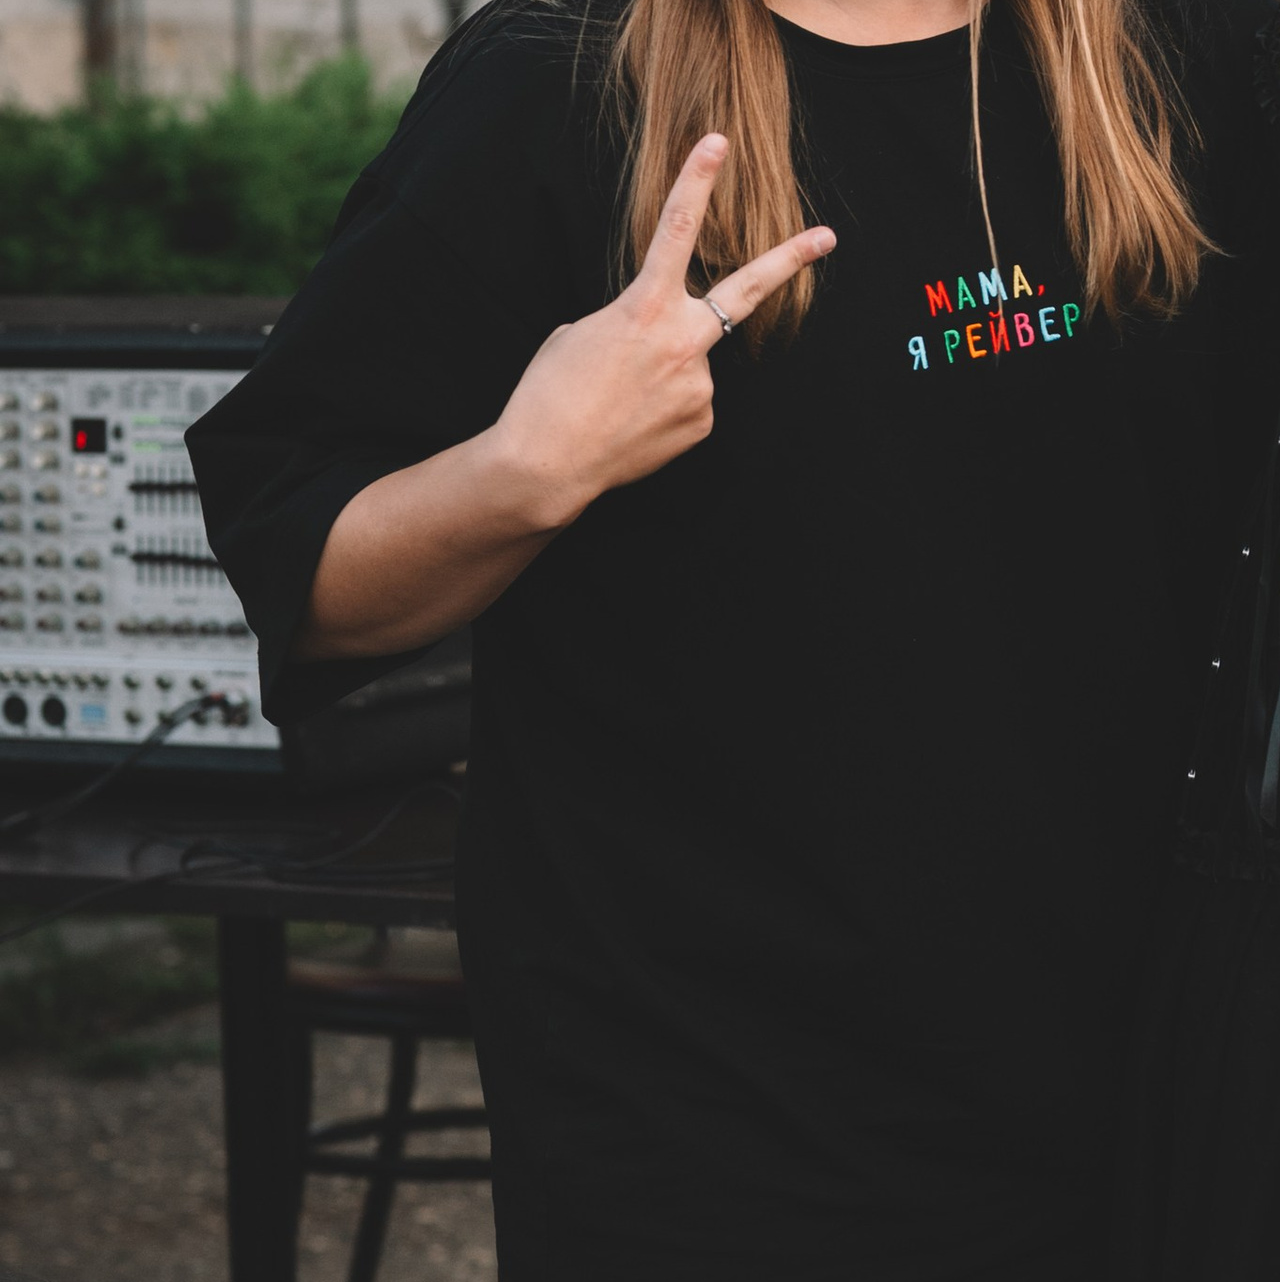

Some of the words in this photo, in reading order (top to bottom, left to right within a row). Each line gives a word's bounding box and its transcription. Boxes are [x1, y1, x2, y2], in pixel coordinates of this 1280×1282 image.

[924, 264, 1046, 317] МАМА,
[907, 335, 929, 371] Я
[943, 302, 1081, 364] РЕЙВЕР
